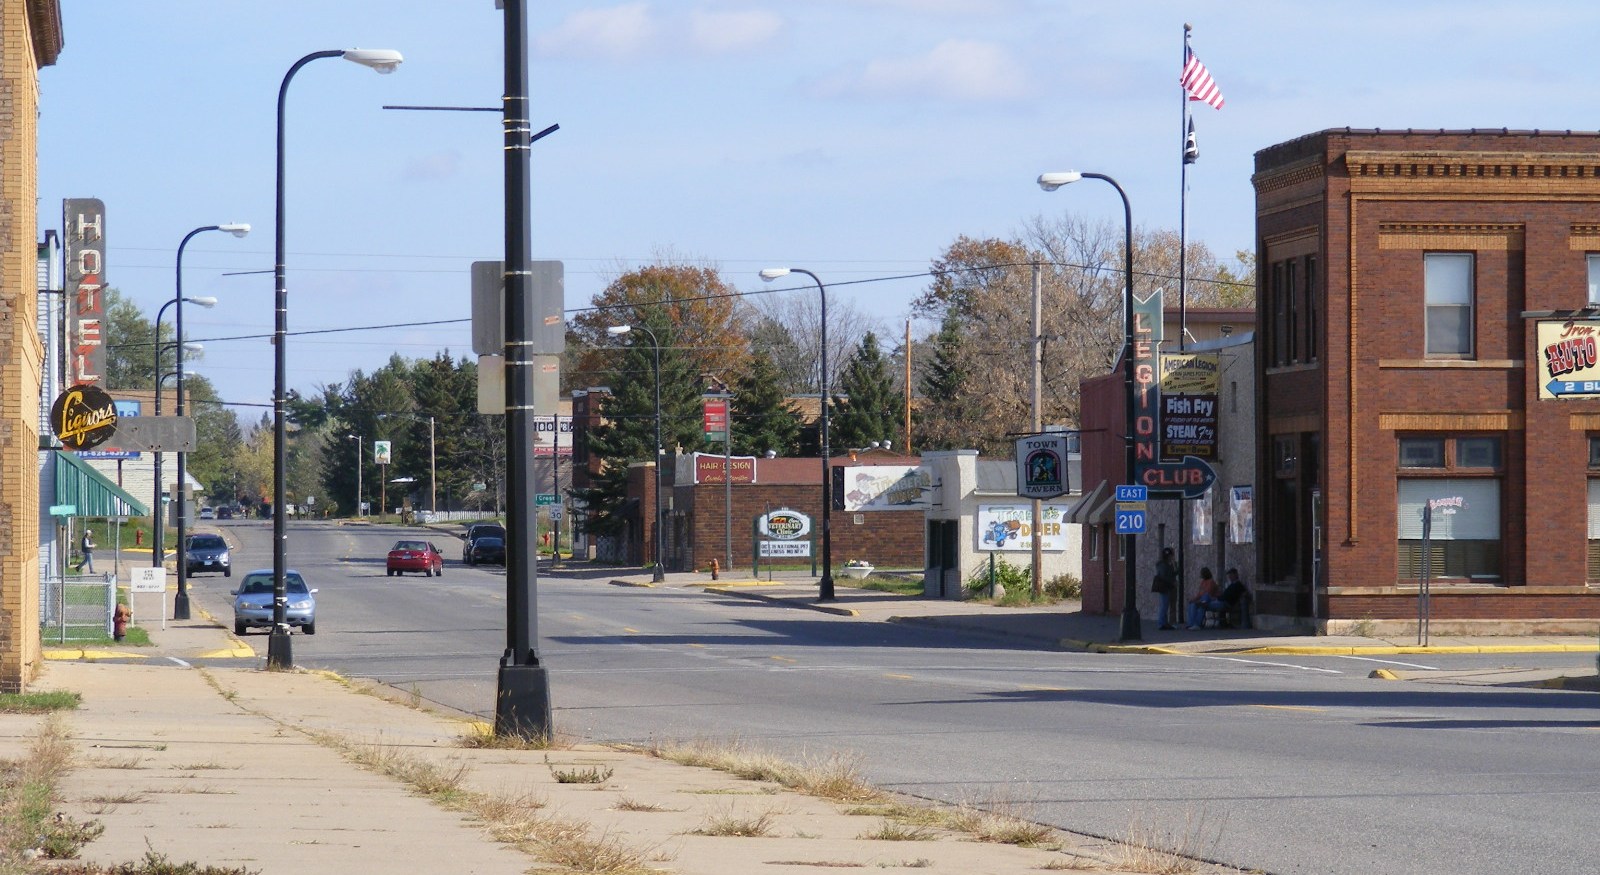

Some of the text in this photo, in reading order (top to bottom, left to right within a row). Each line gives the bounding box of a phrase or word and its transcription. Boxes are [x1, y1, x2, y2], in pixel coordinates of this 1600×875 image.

[78, 213, 101, 381] HOTEL
[1560, 320, 1595, 337] Iron
[1546, 336, 1597, 376] AUTO
[1164, 357, 1217, 373] AMERICAN LEGION
[1135, 313, 1154, 460] LEGION
[1565, 382, 1575, 391] 2
[1167, 397, 1214, 416] Fish Fry
[58, 391, 116, 446] Liquors
[1167, 425, 1214, 440] STEAK Fry
[1026, 441, 1058, 449] TOWN
[1143, 468, 1204, 486] CLUB
[1026, 485, 1063, 493] TAVERN
[1121, 489, 1142, 498] EAST
[1021, 523, 1060, 536] DER
[1119, 515, 1142, 529] 210
